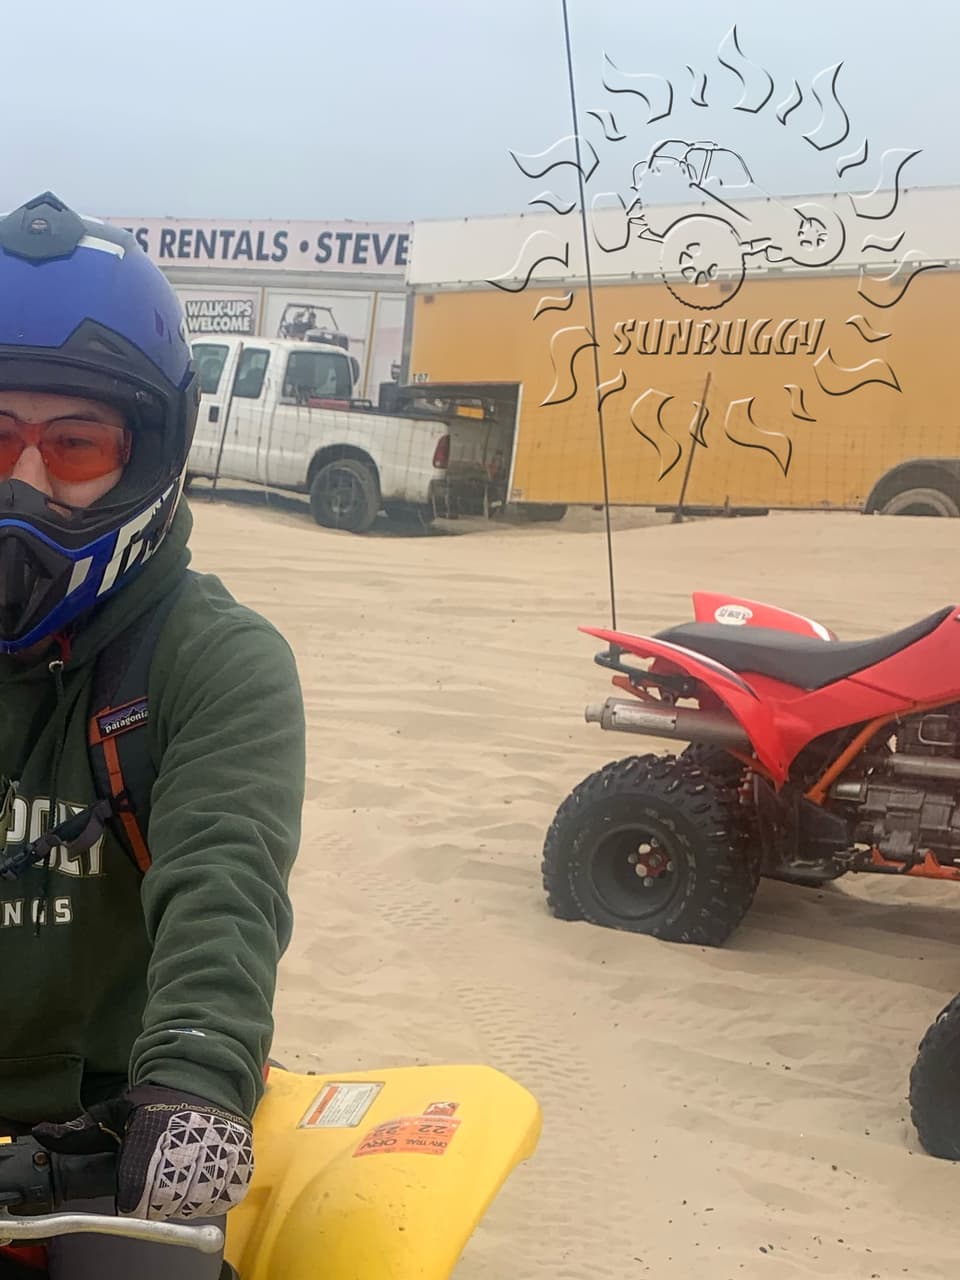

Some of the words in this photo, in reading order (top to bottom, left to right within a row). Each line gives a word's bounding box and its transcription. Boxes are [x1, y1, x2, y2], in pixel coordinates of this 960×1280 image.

[159, 228, 289, 262] RENTALS
[187, 301, 252, 317] WALK-UPS
[187, 316, 250, 332] WELCOME
